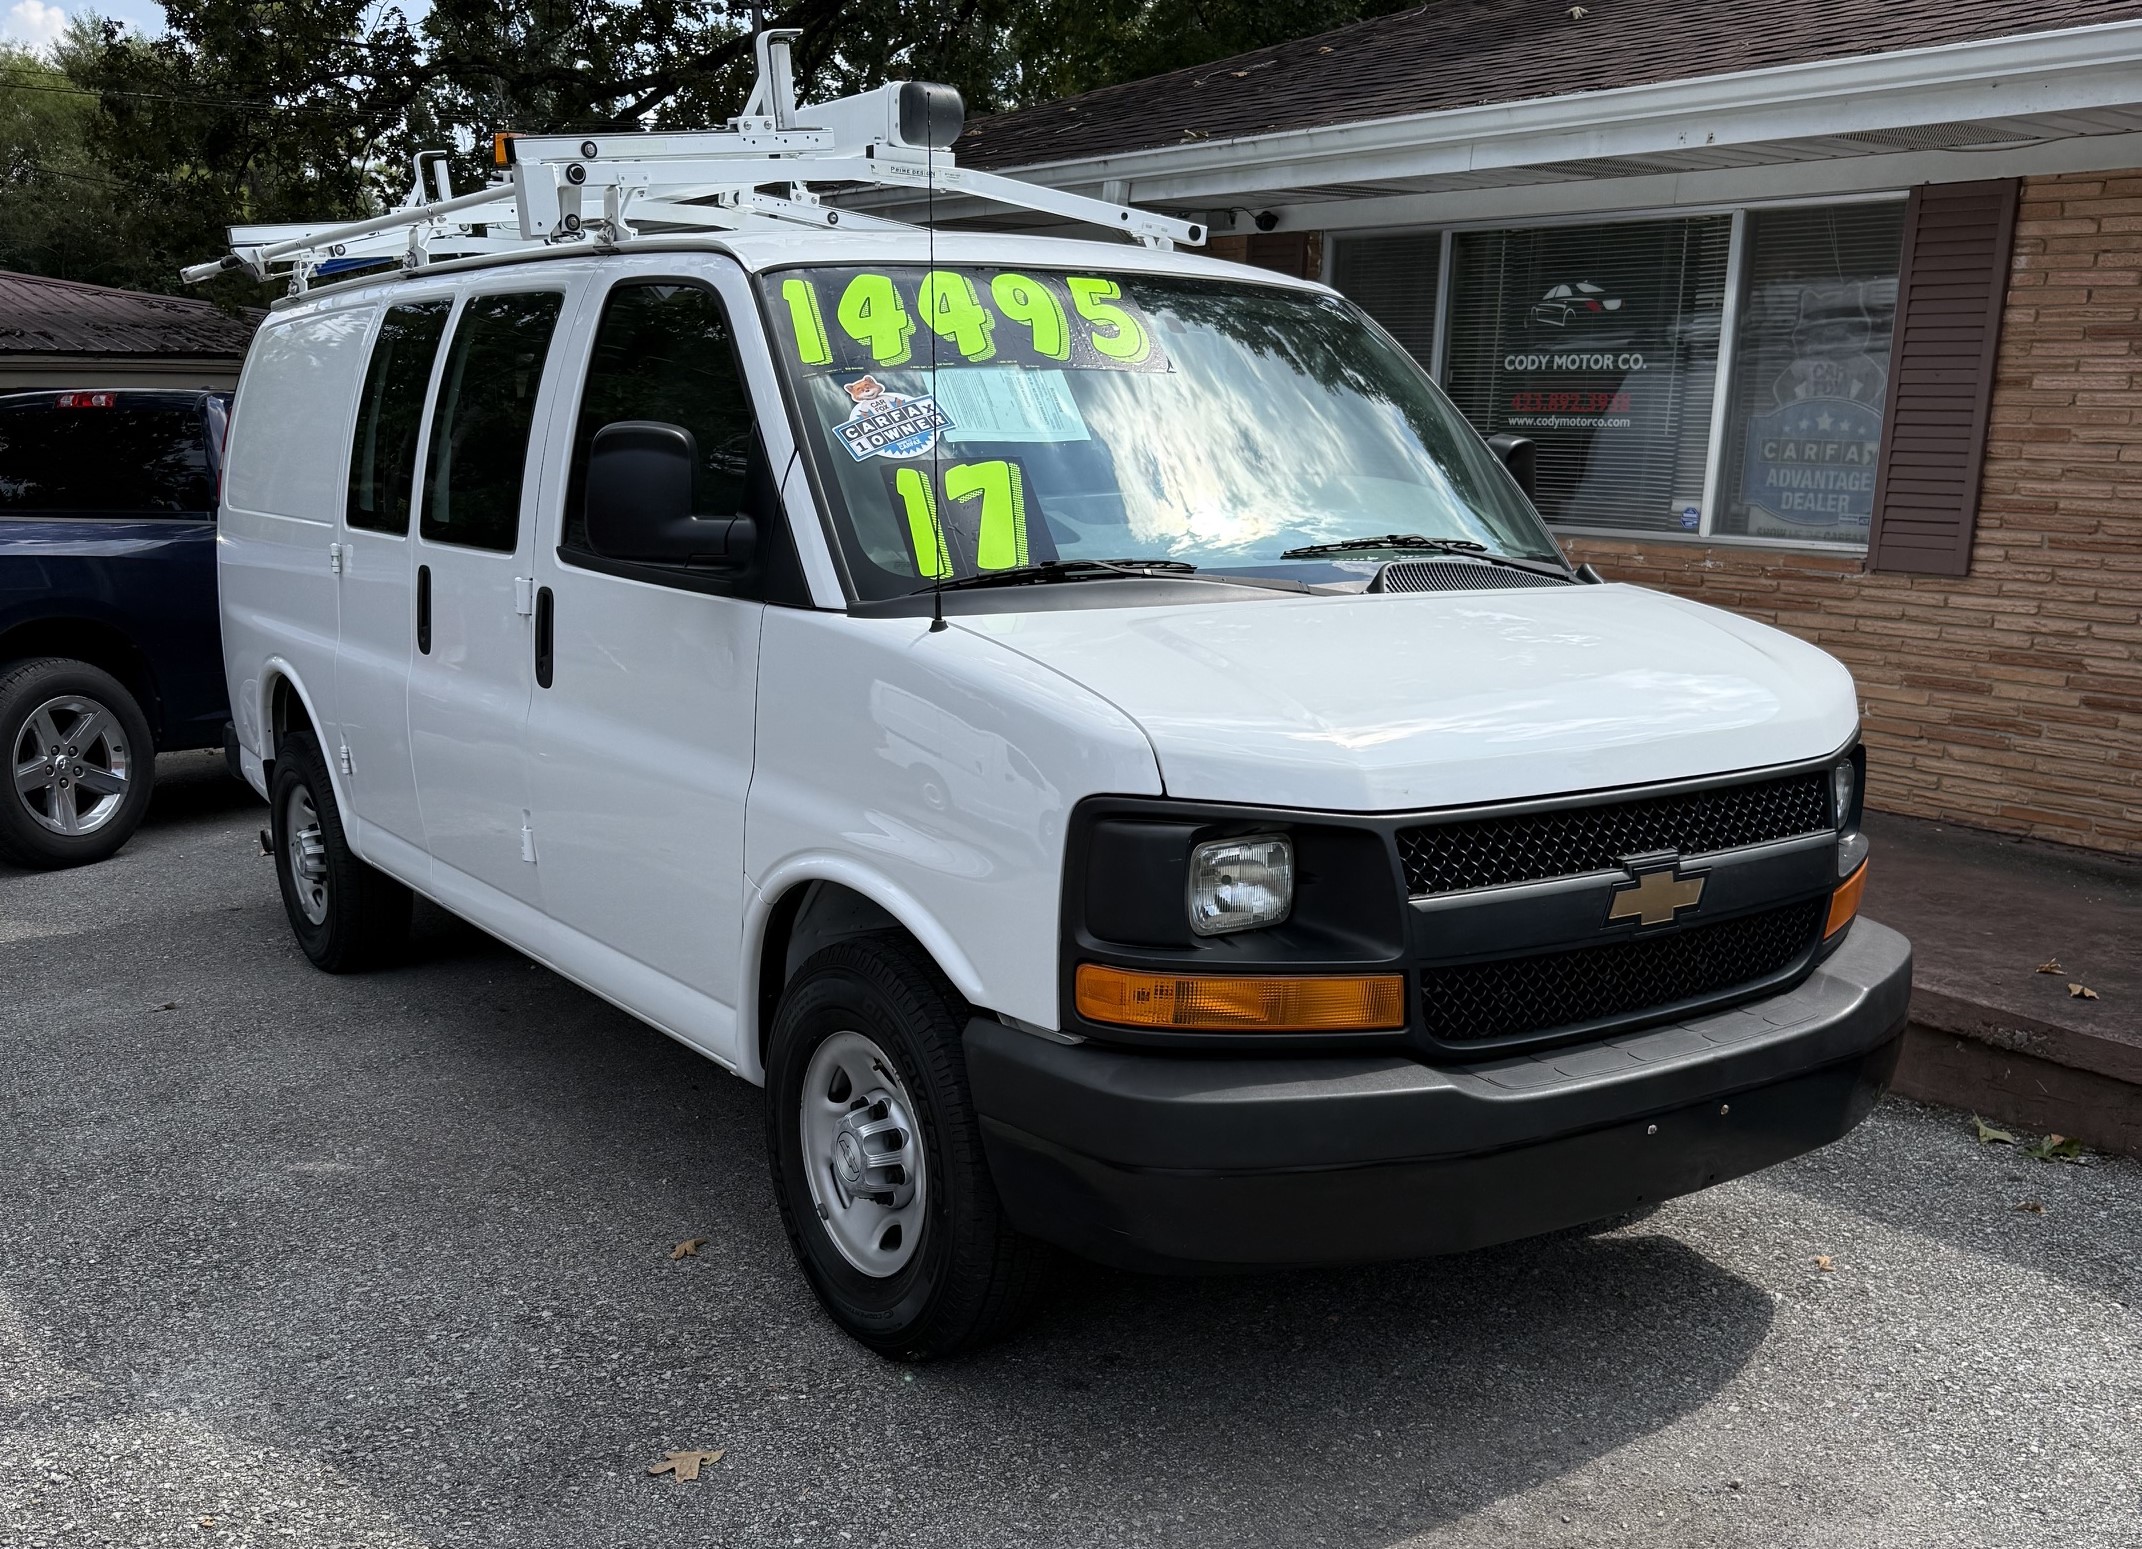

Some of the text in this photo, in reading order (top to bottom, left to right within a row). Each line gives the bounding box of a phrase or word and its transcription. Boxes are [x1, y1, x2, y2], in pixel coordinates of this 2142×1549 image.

[781, 270, 1151, 367] 14495
[1504, 353, 1648, 371] CODY MOTOR CO.
[870, 398, 886, 408] CAR
[875, 405, 889, 414] FOX
[845, 403, 936, 439] CARFAX
[1508, 415, 1631, 430] www.codymotorco.com
[855, 441, 869, 453] 1
[871, 416, 946, 446] OWNER
[1766, 468, 1872, 491] ADVANTAGE
[1781, 492, 1850, 513] DEALER
[895, 460, 1029, 581] 17
